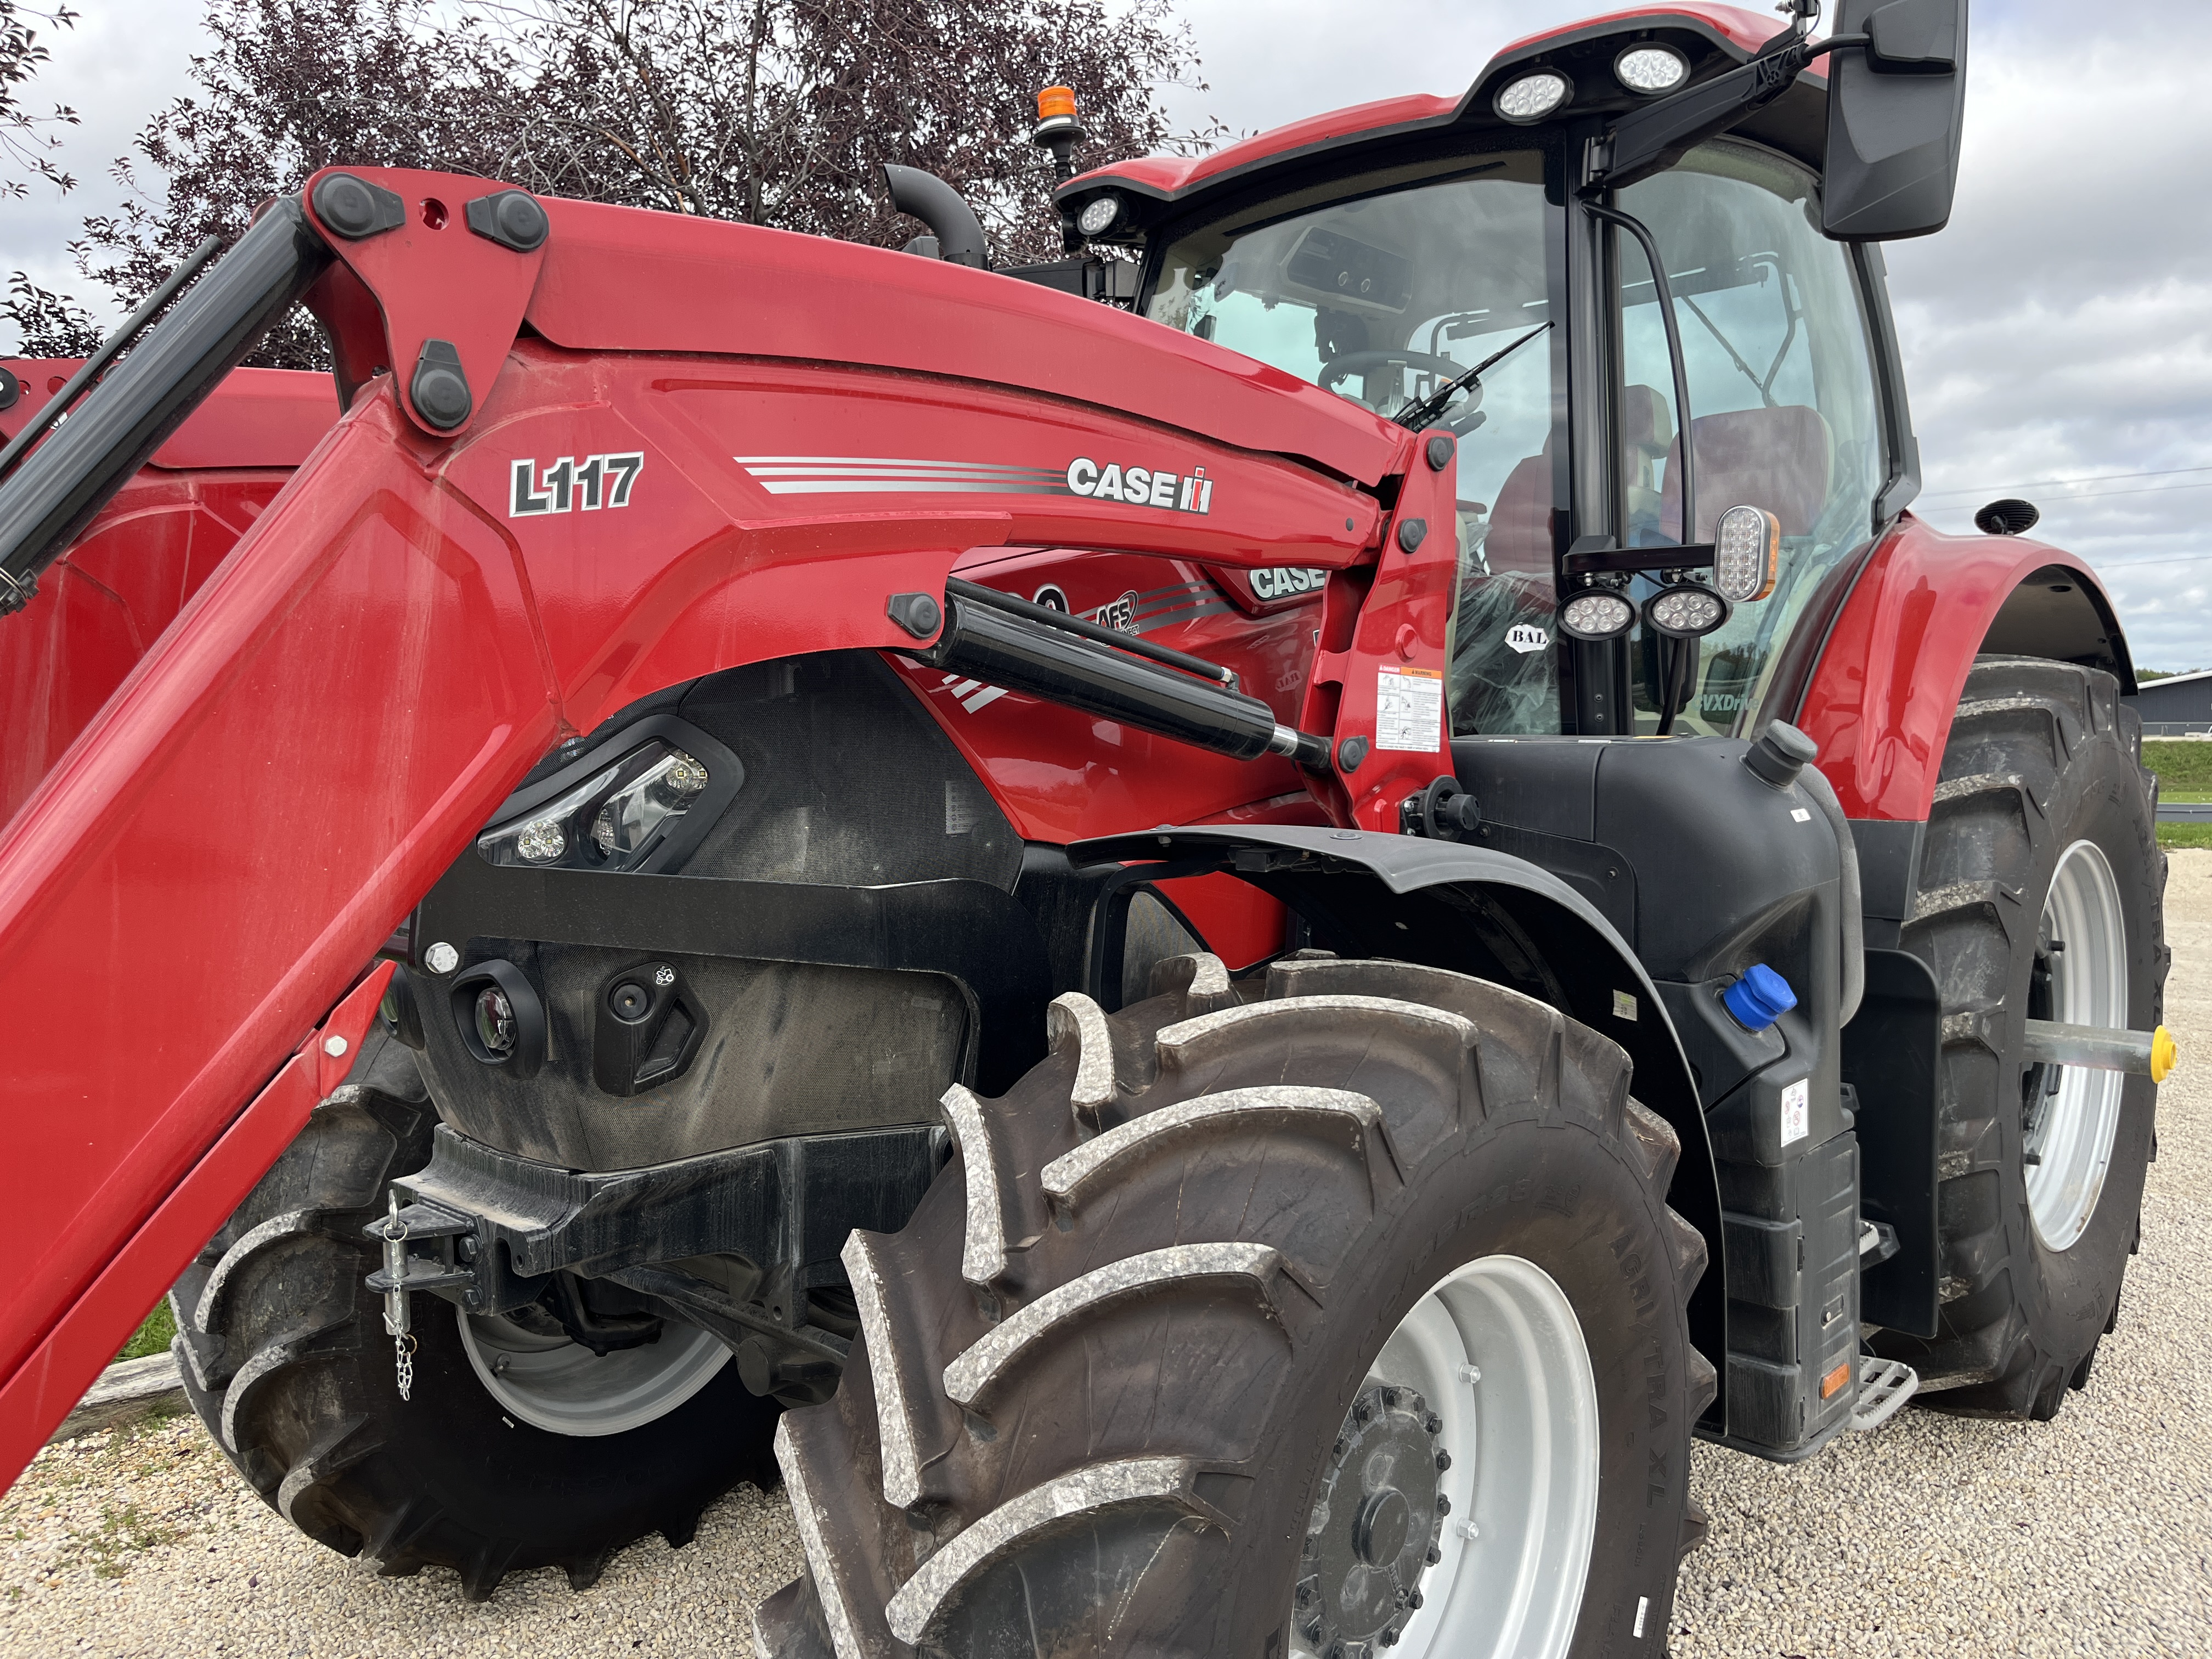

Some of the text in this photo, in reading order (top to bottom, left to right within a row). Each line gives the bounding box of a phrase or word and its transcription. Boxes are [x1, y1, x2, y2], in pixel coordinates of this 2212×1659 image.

[509, 451, 644, 518] L117
[1067, 458, 1178, 508] CASE
[1250, 568, 1325, 599] CASE
[1097, 598, 1132, 631] AFS
[1512, 630, 1547, 644] BAL
